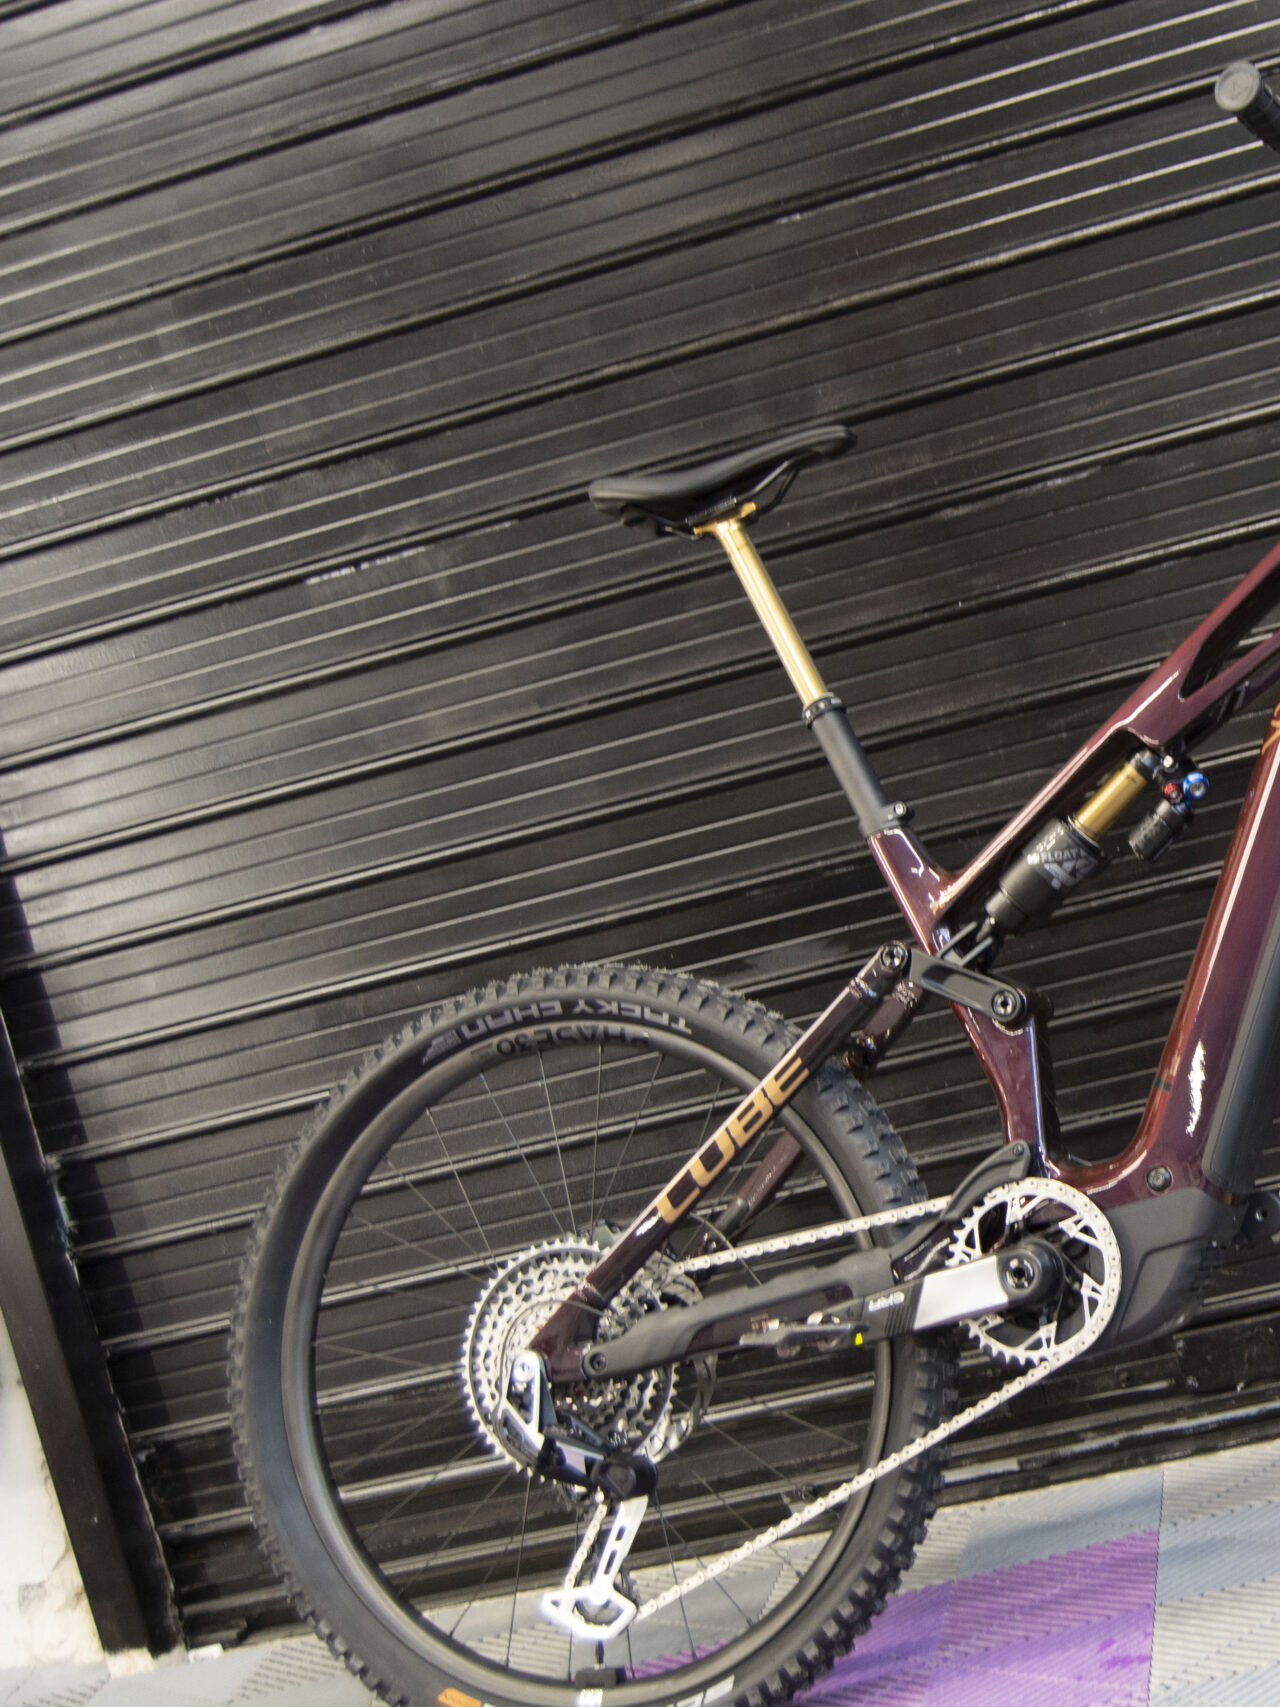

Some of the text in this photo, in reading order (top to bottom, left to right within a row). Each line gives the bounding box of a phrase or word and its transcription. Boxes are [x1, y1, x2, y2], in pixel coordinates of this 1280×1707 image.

[460, 998, 692, 1040] TACKY CHAN
[656, 1057, 809, 1224] CUBE
